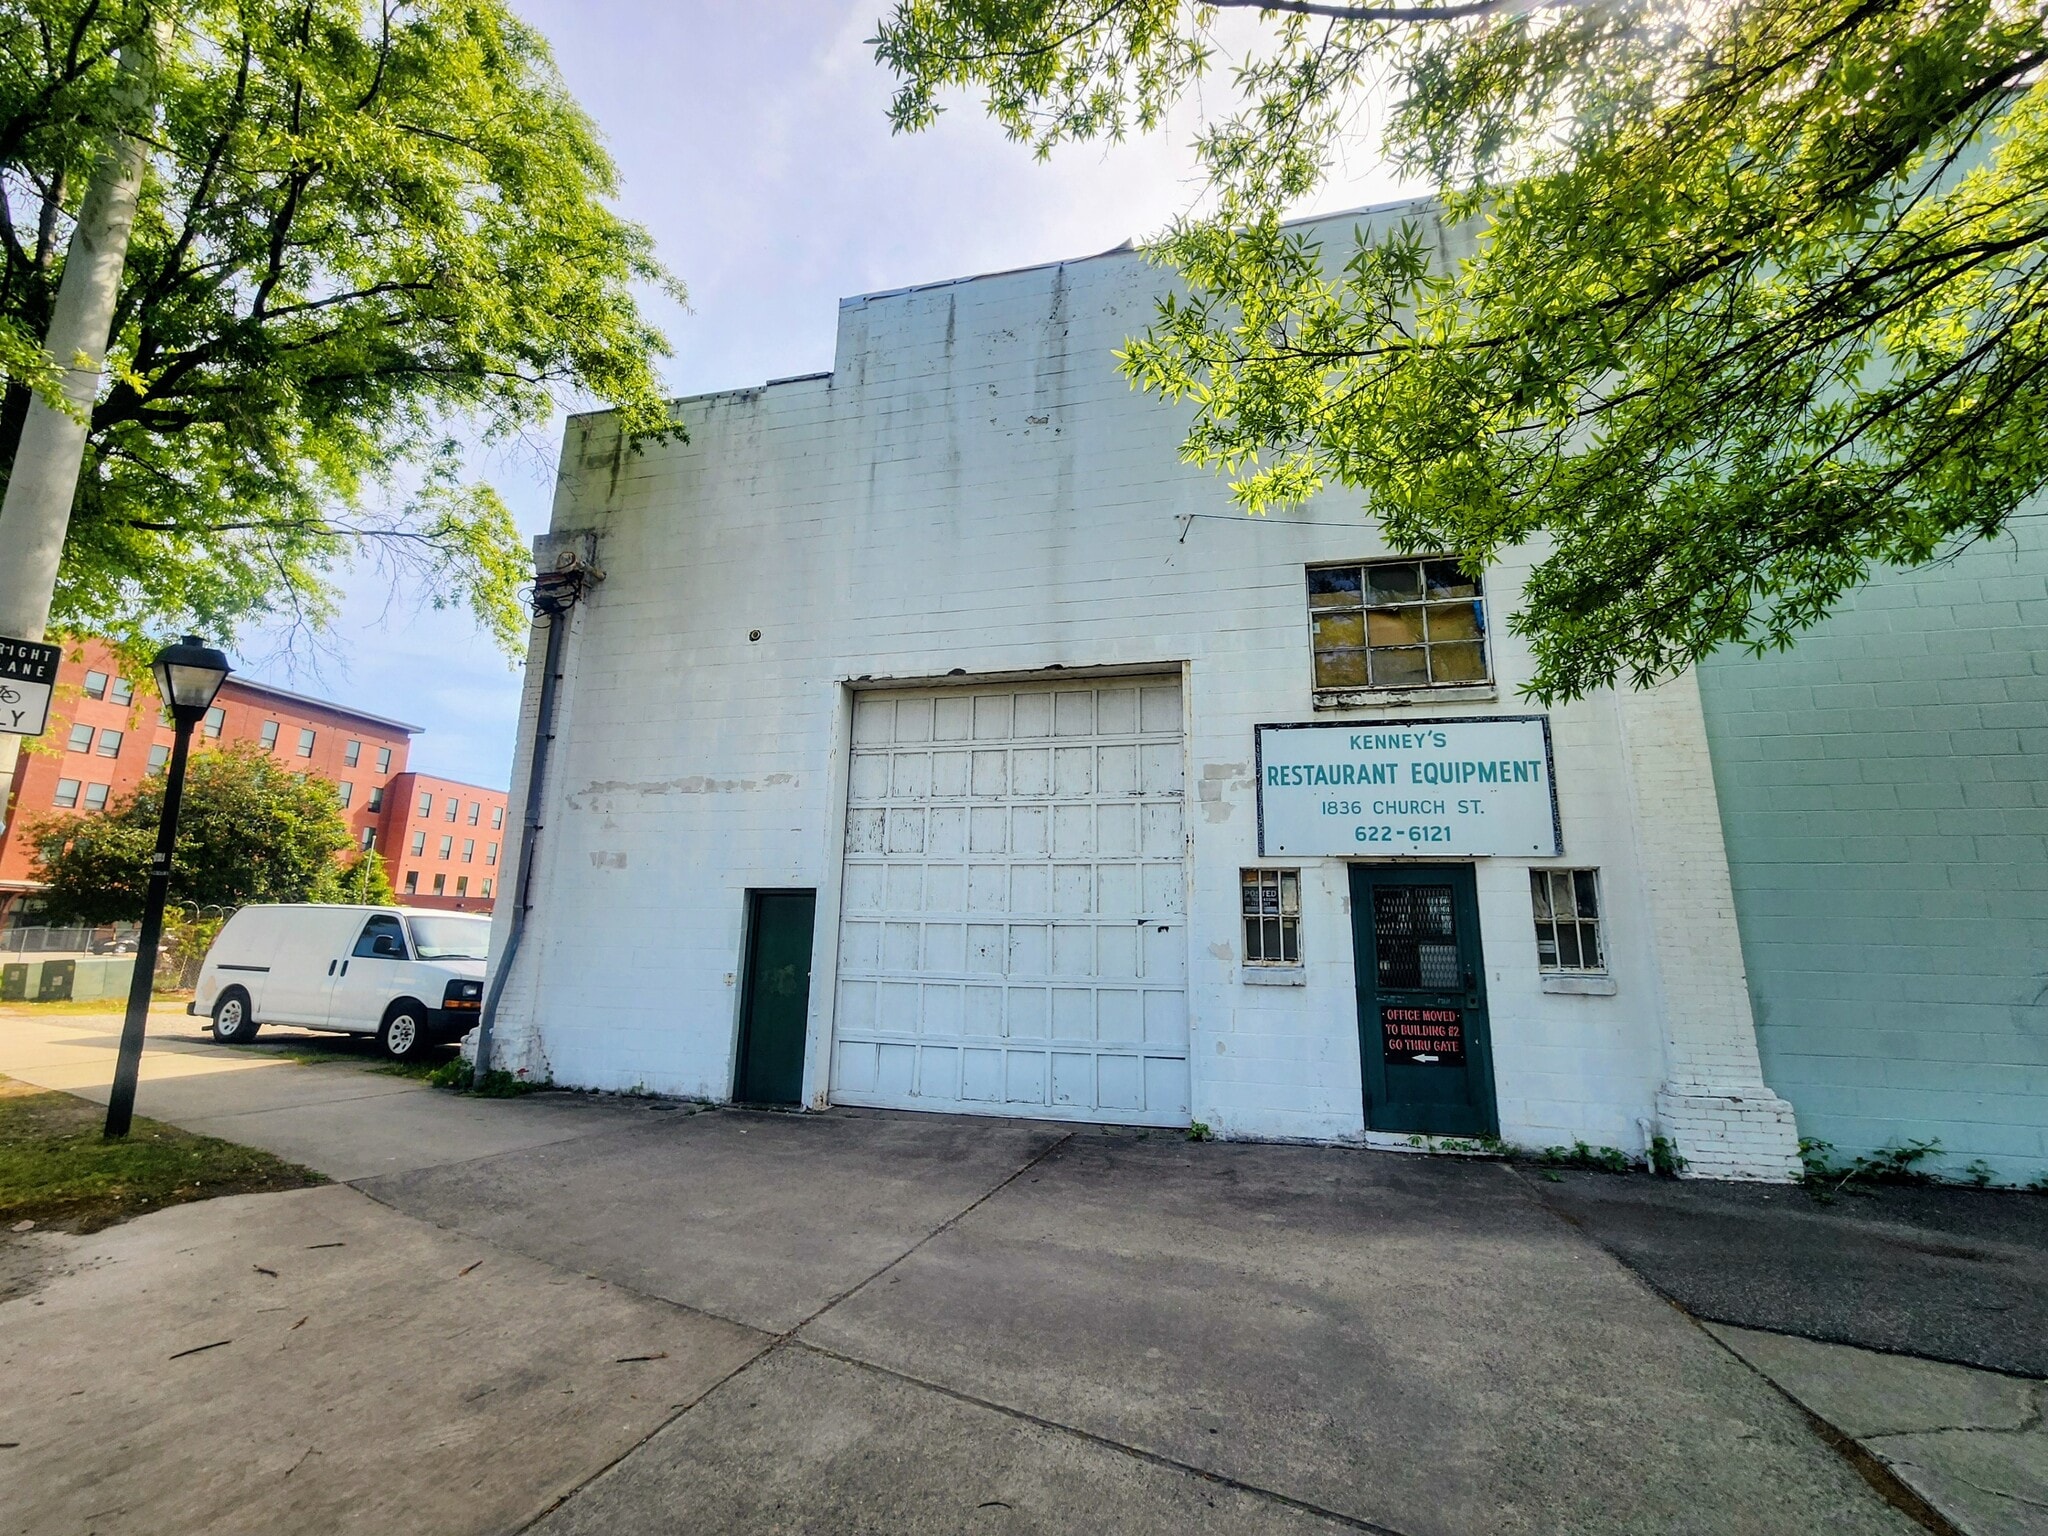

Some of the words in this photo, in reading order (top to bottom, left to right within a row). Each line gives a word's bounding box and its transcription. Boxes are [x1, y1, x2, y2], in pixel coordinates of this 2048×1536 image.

[0, 661, 45, 677] ANE
[1350, 730, 1447, 750] KENNEY'S
[1267, 762, 1398, 786] RESTAURANT
[1411, 760, 1541, 785] EQUIPMENT
[1322, 800, 1362, 815] 1836
[1373, 800, 1445, 815] CHURCH
[1458, 800, 1485, 815] ST.
[1355, 825, 1451, 842] 622-6121
[1387, 1009, 1420, 1020] OFFICE
[1423, 1010, 1455, 1022] MOVED
[1386, 1024, 1398, 1035] TO
[1401, 1025, 1445, 1036] BUILDING
[1389, 1039, 1402, 1050] GO
[1405, 1039, 1430, 1051] THRU
[1433, 1041, 1459, 1052] GATE
